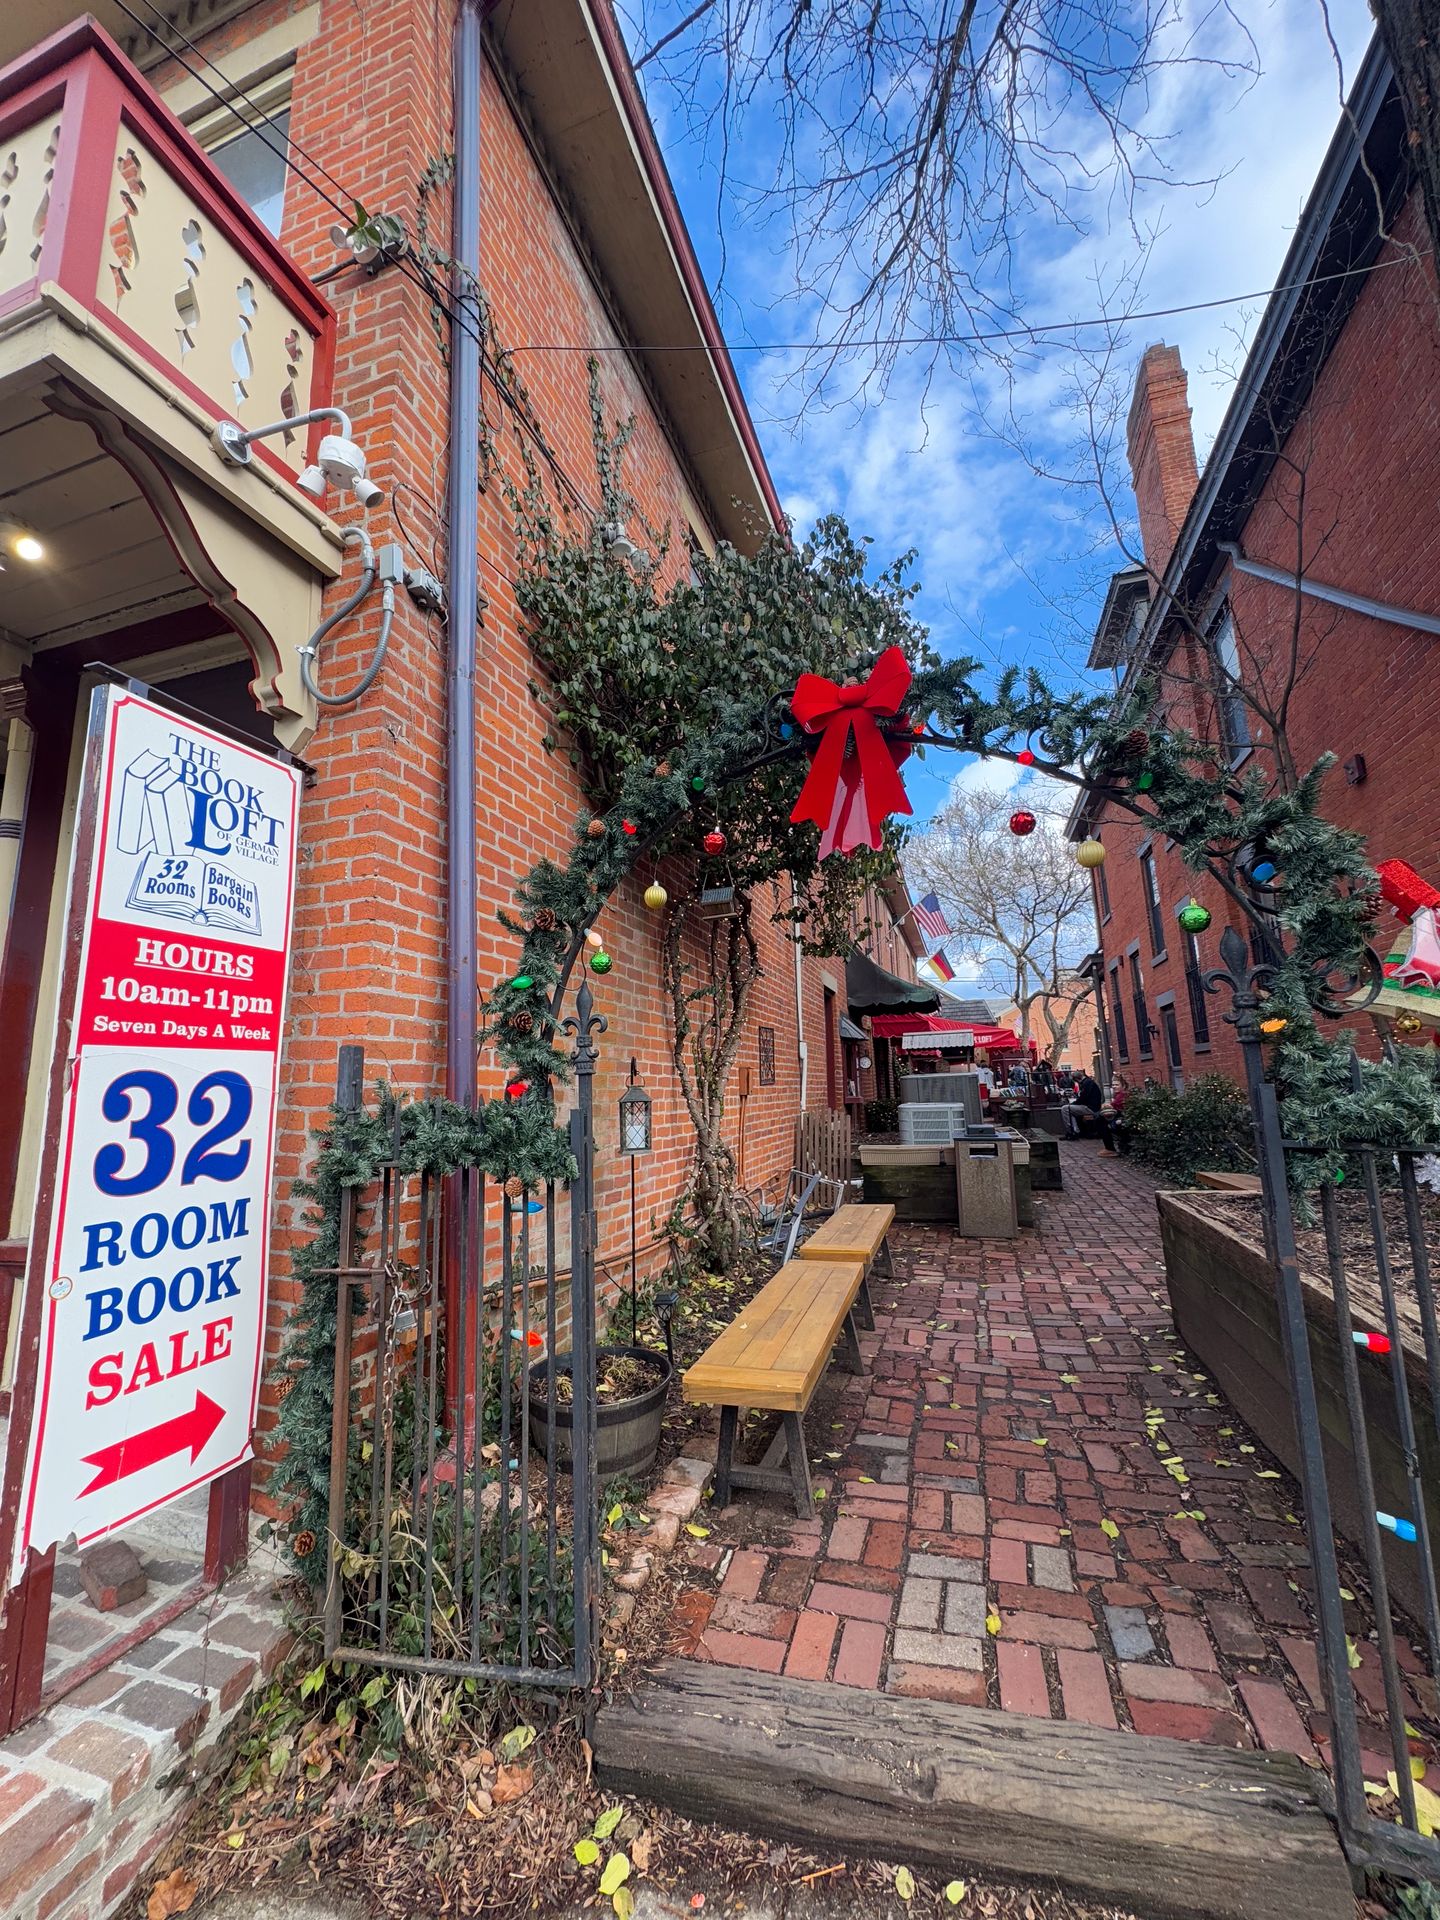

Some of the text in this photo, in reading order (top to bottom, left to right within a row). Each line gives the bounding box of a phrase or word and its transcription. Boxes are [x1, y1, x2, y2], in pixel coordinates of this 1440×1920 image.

[169, 733, 221, 772] THE
[179, 758, 265, 813] BOOK
[185, 786, 285, 856] LOFT
[216, 830, 280, 857] OF GERMAN
[235, 847, 280, 867] VILLAGE
[144, 877, 197, 899] Rooms
[156, 858, 189, 880] 32
[207, 867, 253, 902] Bargain
[207, 887, 252, 919] Books
[134, 938, 254, 978] HOURS
[100, 976, 273, 1018] 10am-11pm
[93, 1015, 271, 1041] Seven Days A Week
[978, 1035, 993, 1043] LOFT
[93, 1069, 253, 1197] 32
[79, 1197, 251, 1273] ROOM
[82, 1255, 243, 1342] BOOK
[85, 1316, 234, 1411] SALE
